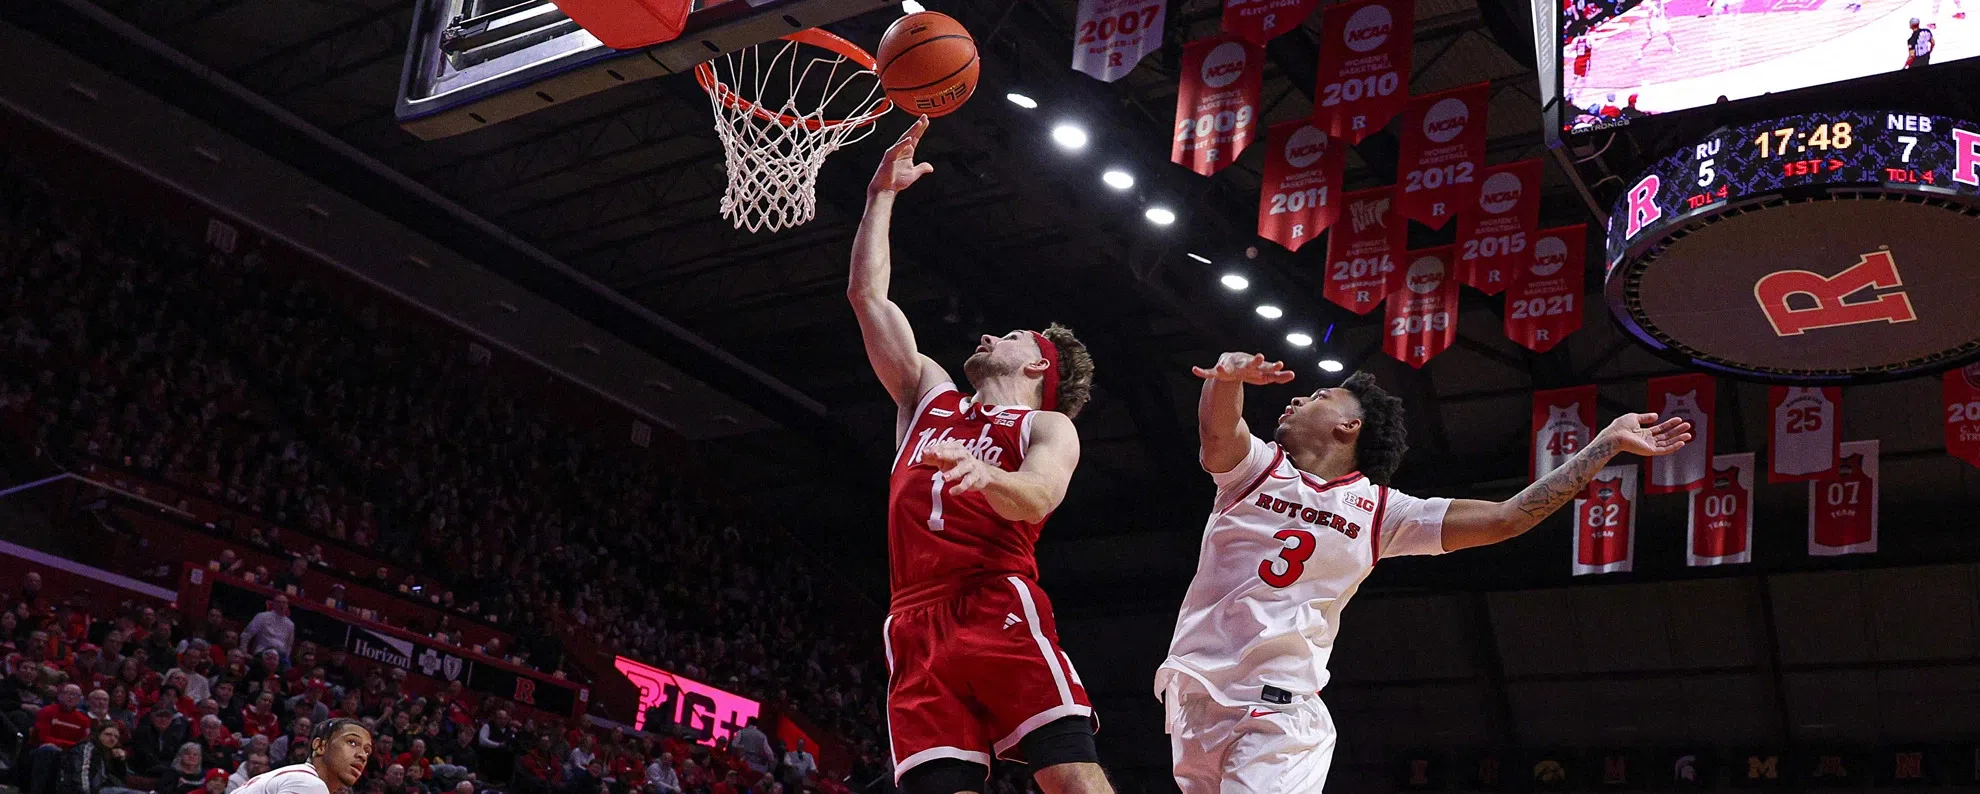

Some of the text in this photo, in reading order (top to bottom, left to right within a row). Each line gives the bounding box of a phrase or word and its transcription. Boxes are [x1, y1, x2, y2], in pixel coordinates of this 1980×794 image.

[1079, 5, 1160, 45] 2007
[1347, 23, 1390, 42] NCAA
[1108, 52, 1122, 67] R
[1206, 60, 1244, 79] NCAA
[916, 82, 967, 109] ELITE
[1322, 71, 1399, 107] 2010
[1177, 105, 1253, 141] 2009
[1352, 115, 1366, 130] R
[1427, 116, 1466, 133] NCAA
[1887, 113, 1933, 133] NEB
[1696, 138, 1721, 161] RU
[1754, 122, 1852, 158] 17:48
[1898, 135, 1918, 163] 7
[1206, 148, 1220, 163] R
[1783, 159, 1824, 177] 1ST
[1405, 161, 1475, 193] 2012
[1697, 158, 1716, 187] 5
[1885, 168, 1935, 184] TOL 4
[1270, 186, 1328, 215] 2011
[1483, 189, 1521, 203] NCAA
[1625, 174, 1662, 240] R
[1686, 184, 1730, 209] TOL 4
[1432, 202, 1446, 217] R
[1291, 224, 1304, 239] R
[1462, 232, 1527, 261] 2015
[1536, 252, 1565, 266] NCAA
[1332, 253, 1396, 281] 2014
[1488, 270, 1501, 282] R
[1356, 291, 1370, 302] R
[1754, 250, 1917, 337] R
[1511, 294, 1574, 319] 2021
[1391, 311, 1449, 336] 2019
[1536, 330, 1549, 341] R
[1786, 407, 1822, 433] 25
[1547, 431, 1578, 456] 45
[927, 470, 945, 531] 1
[1705, 493, 1737, 518] 00
[1828, 481, 1860, 506] 07
[1255, 493, 1361, 539] RUTGERS
[1588, 503, 1619, 527] 82
[1258, 530, 1316, 588] 3
[354, 638, 412, 670] Horizon
[514, 676, 536, 705] R
[1748, 755, 1779, 779] M
